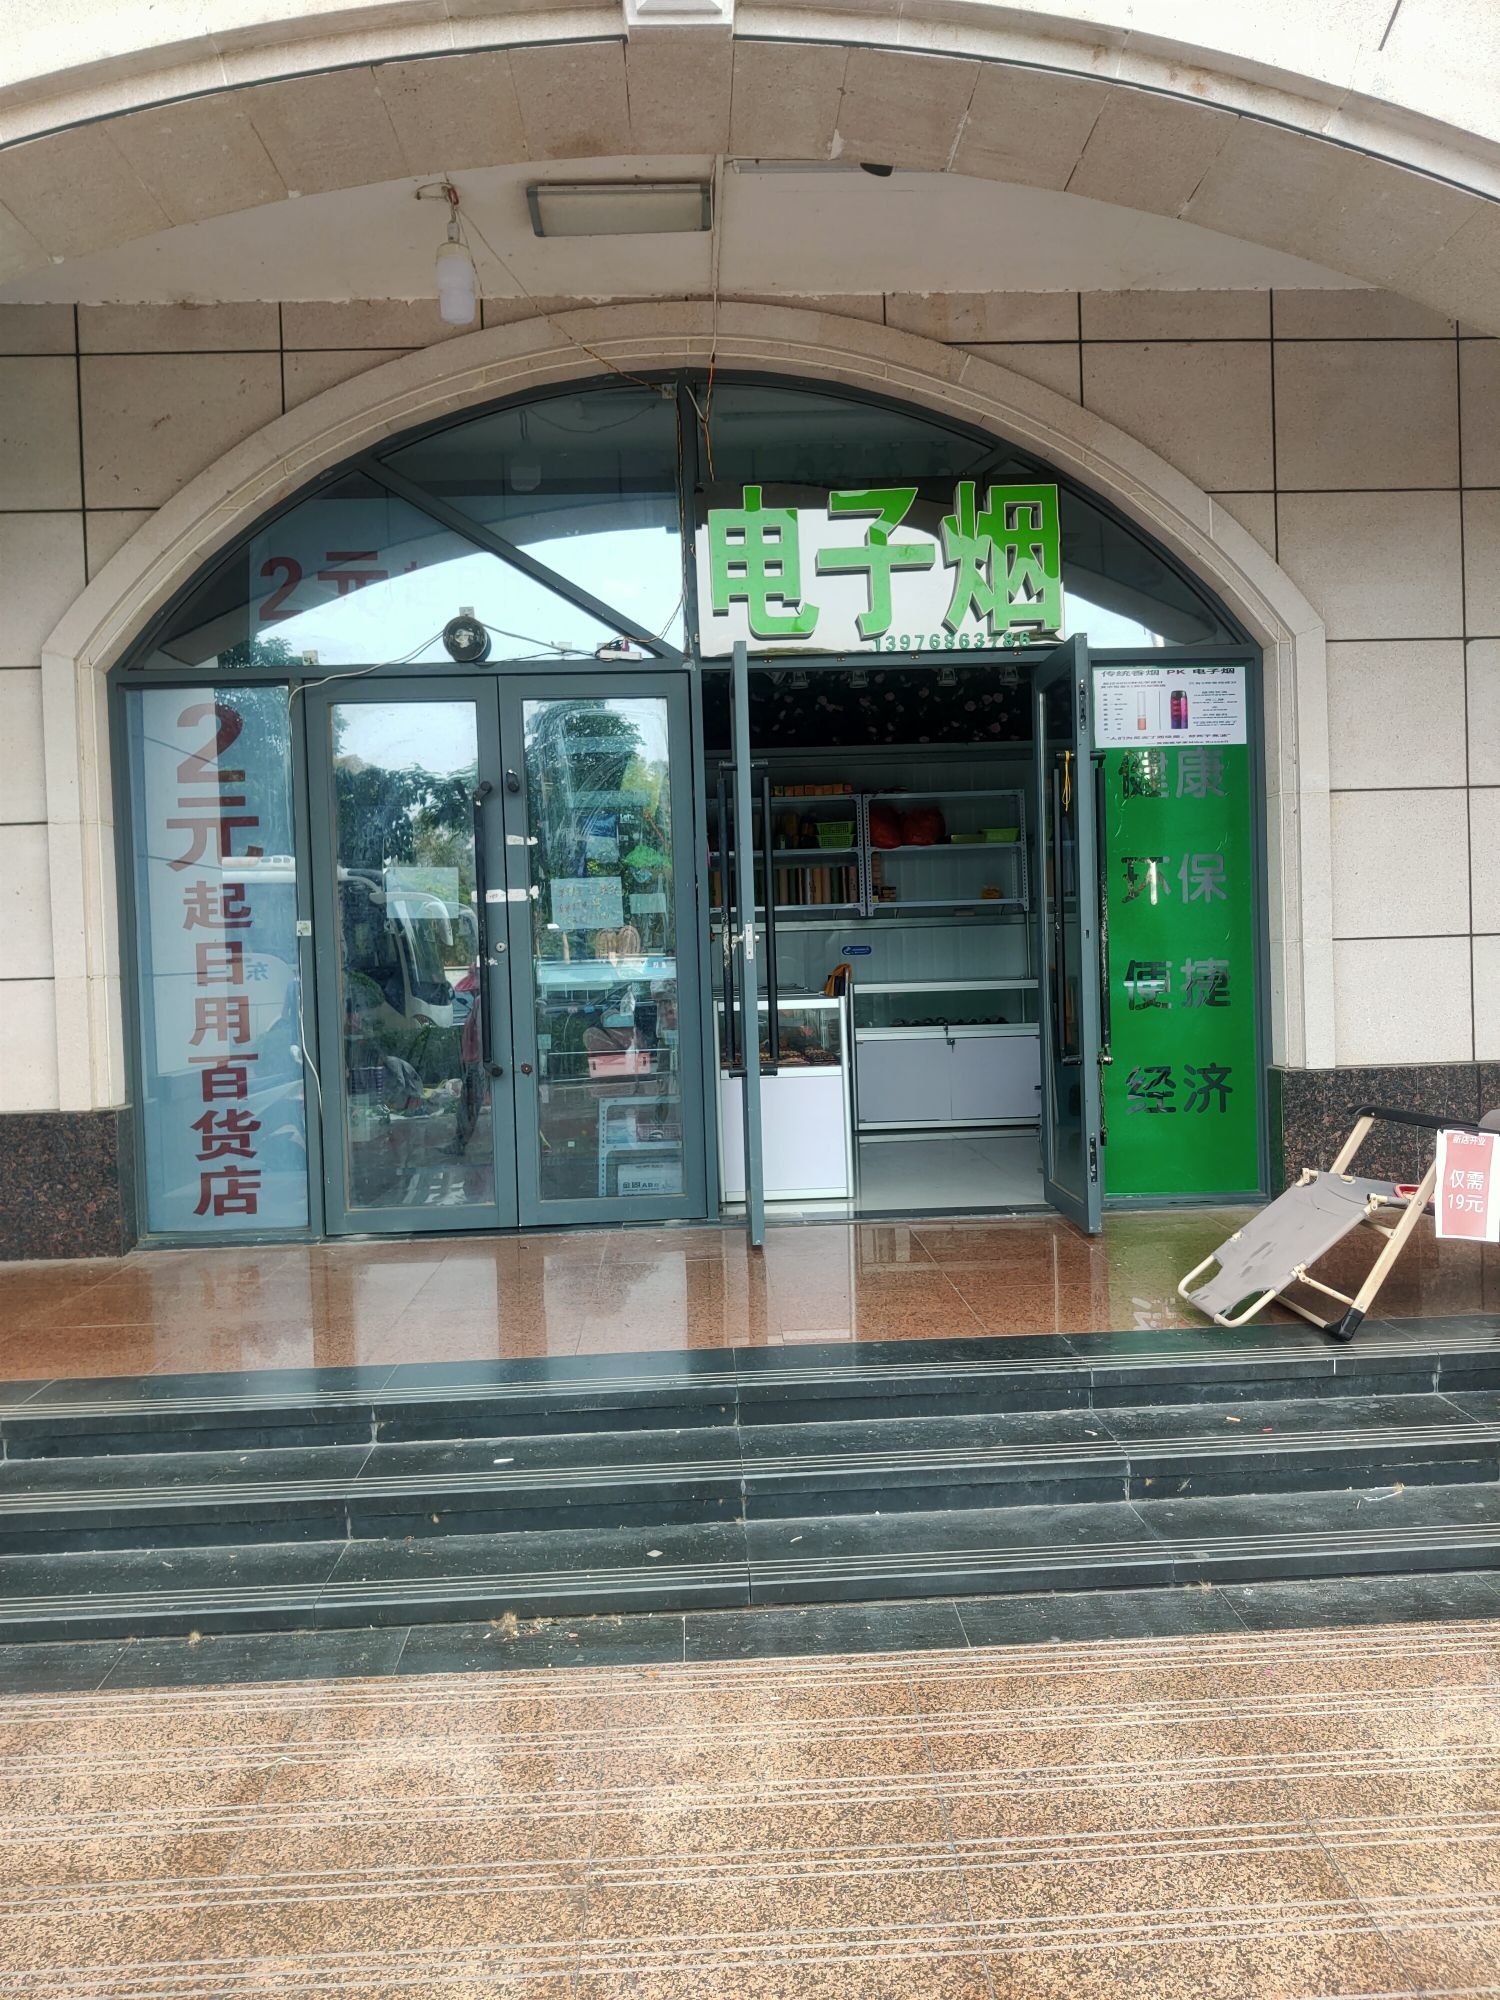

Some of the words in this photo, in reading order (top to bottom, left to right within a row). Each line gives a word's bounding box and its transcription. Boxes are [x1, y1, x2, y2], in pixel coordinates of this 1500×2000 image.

[708, 481, 1064, 639] 电子烟
[259, 551, 418, 621] 2元
[873, 632, 1031, 653] 13976863786
[1101, 669, 1160, 678] 传统香烟
[1192, 667, 1235, 675] 电子烟
[1118, 747, 1226, 798] 健康
[1121, 853, 1228, 905] 环保
[166, 702, 264, 1216] 2元起日用百货店
[1123, 956, 1232, 1011] 便捷
[1125, 1062, 1234, 1114] 经济
[1452, 1134, 1486, 1146] 新店开业
[1447, 1193, 1484, 1213] 19元
[1450, 1168, 1484, 1190] 仅需
